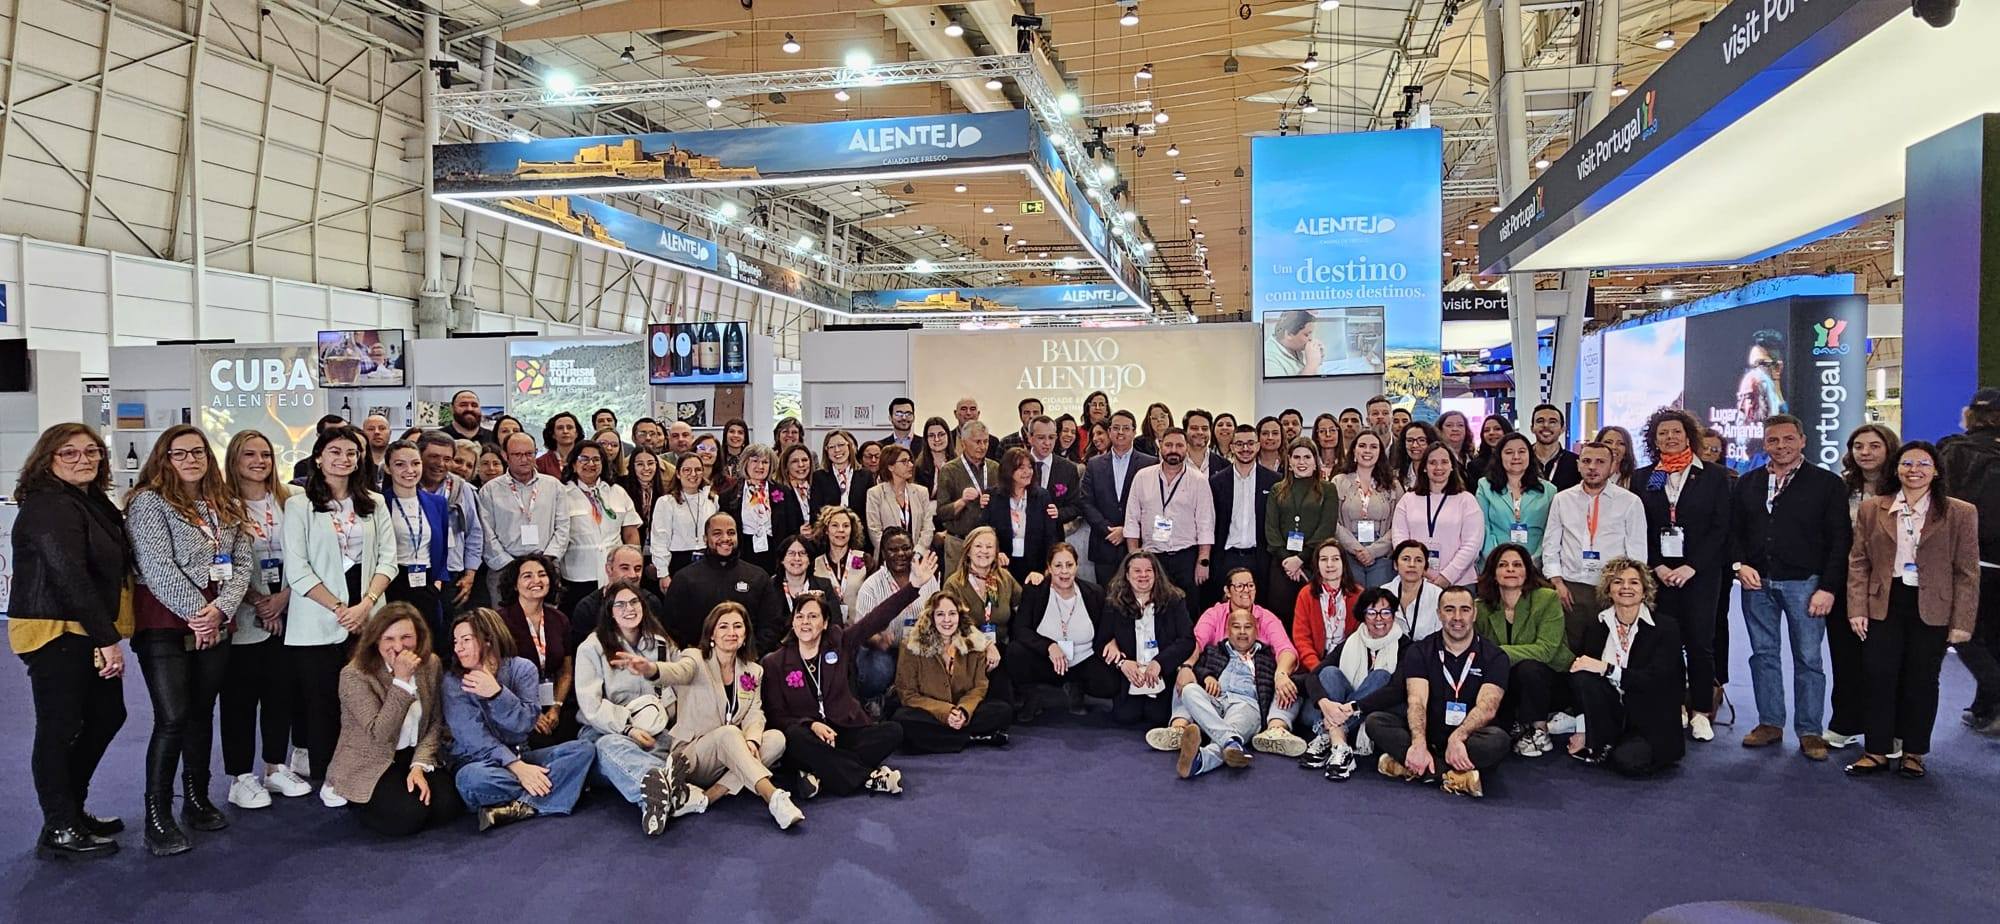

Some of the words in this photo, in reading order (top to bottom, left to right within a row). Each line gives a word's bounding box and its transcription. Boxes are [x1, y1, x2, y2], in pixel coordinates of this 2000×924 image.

[1723, 9, 1760, 65] visit
[847, 122, 983, 153] ALENTEJO
[1577, 148, 1596, 181] visit
[1596, 107, 1641, 167] Portugal
[883, 157, 909, 166] CAIADO
[920, 154, 949, 164] FRESCO
[1294, 215, 1396, 236] ALENTEJO
[1499, 218, 1511, 242] visit
[1510, 196, 1536, 234] Portugal
[1273, 264, 1292, 274] Um
[1296, 255, 1407, 284] destino
[1264, 290, 1297, 302] com
[1301, 285, 1353, 301] muitos
[1356, 284, 1426, 299] destinos.
[1443, 298, 1472, 310] visit
[1041, 336, 1120, 363] BAIXO
[210, 358, 315, 392] CUBA
[549, 360, 576, 369] BEST
[549, 368, 595, 377] TOURISM
[549, 376, 597, 386] VILLAGES
[1016, 363, 1147, 395] ALENTEJO
[212, 393, 315, 407] ALENTEJO
[1710, 406, 1738, 425] Lugar
[1815, 360, 1848, 471] ortugal
